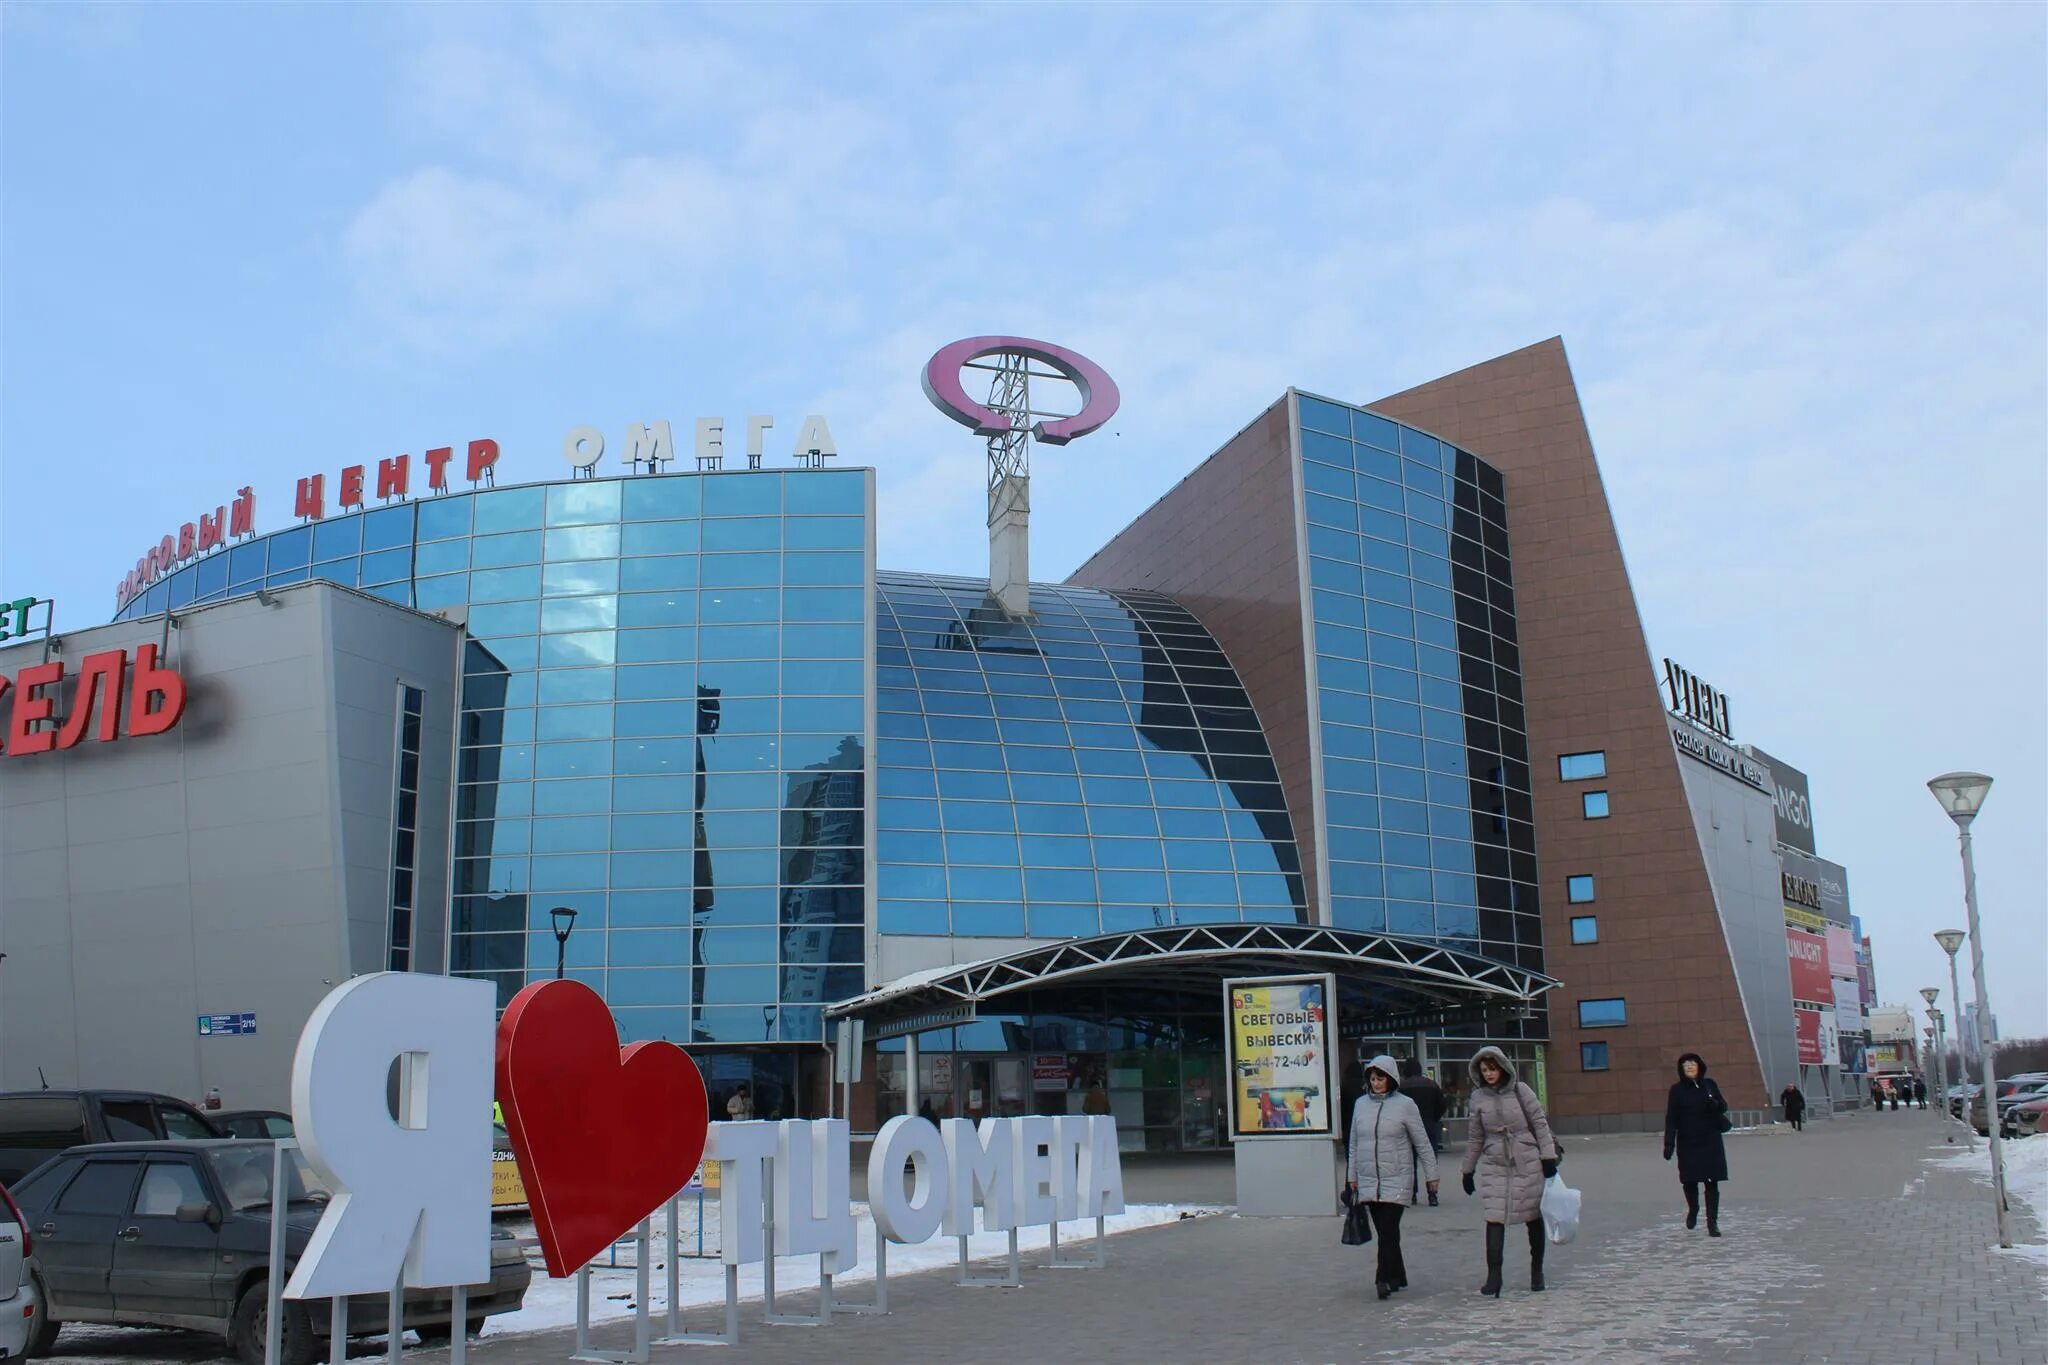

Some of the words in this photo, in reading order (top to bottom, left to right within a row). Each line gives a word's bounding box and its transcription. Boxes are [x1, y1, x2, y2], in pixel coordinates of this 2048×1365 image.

[116, 486, 256, 612] ТОРГОВЫЙ
[295, 438, 499, 520] ЦЕНТР
[562, 414, 838, 468] ОМЕГА
[1664, 657, 1735, 740] VIERI
[1674, 729, 1704, 756] салон
[1705, 745, 1729, 769] кожи
[1741, 763, 1763, 786] меха
[1241, 1011, 1315, 1026] СВЕТОВЫЕ
[1246, 1033, 1312, 1047] ВЫВЕСКИ
[282, 971, 498, 1300] Я
[706, 1118, 858, 1275] ТЦ
[868, 1114, 1125, 1244] ОМЕГА
